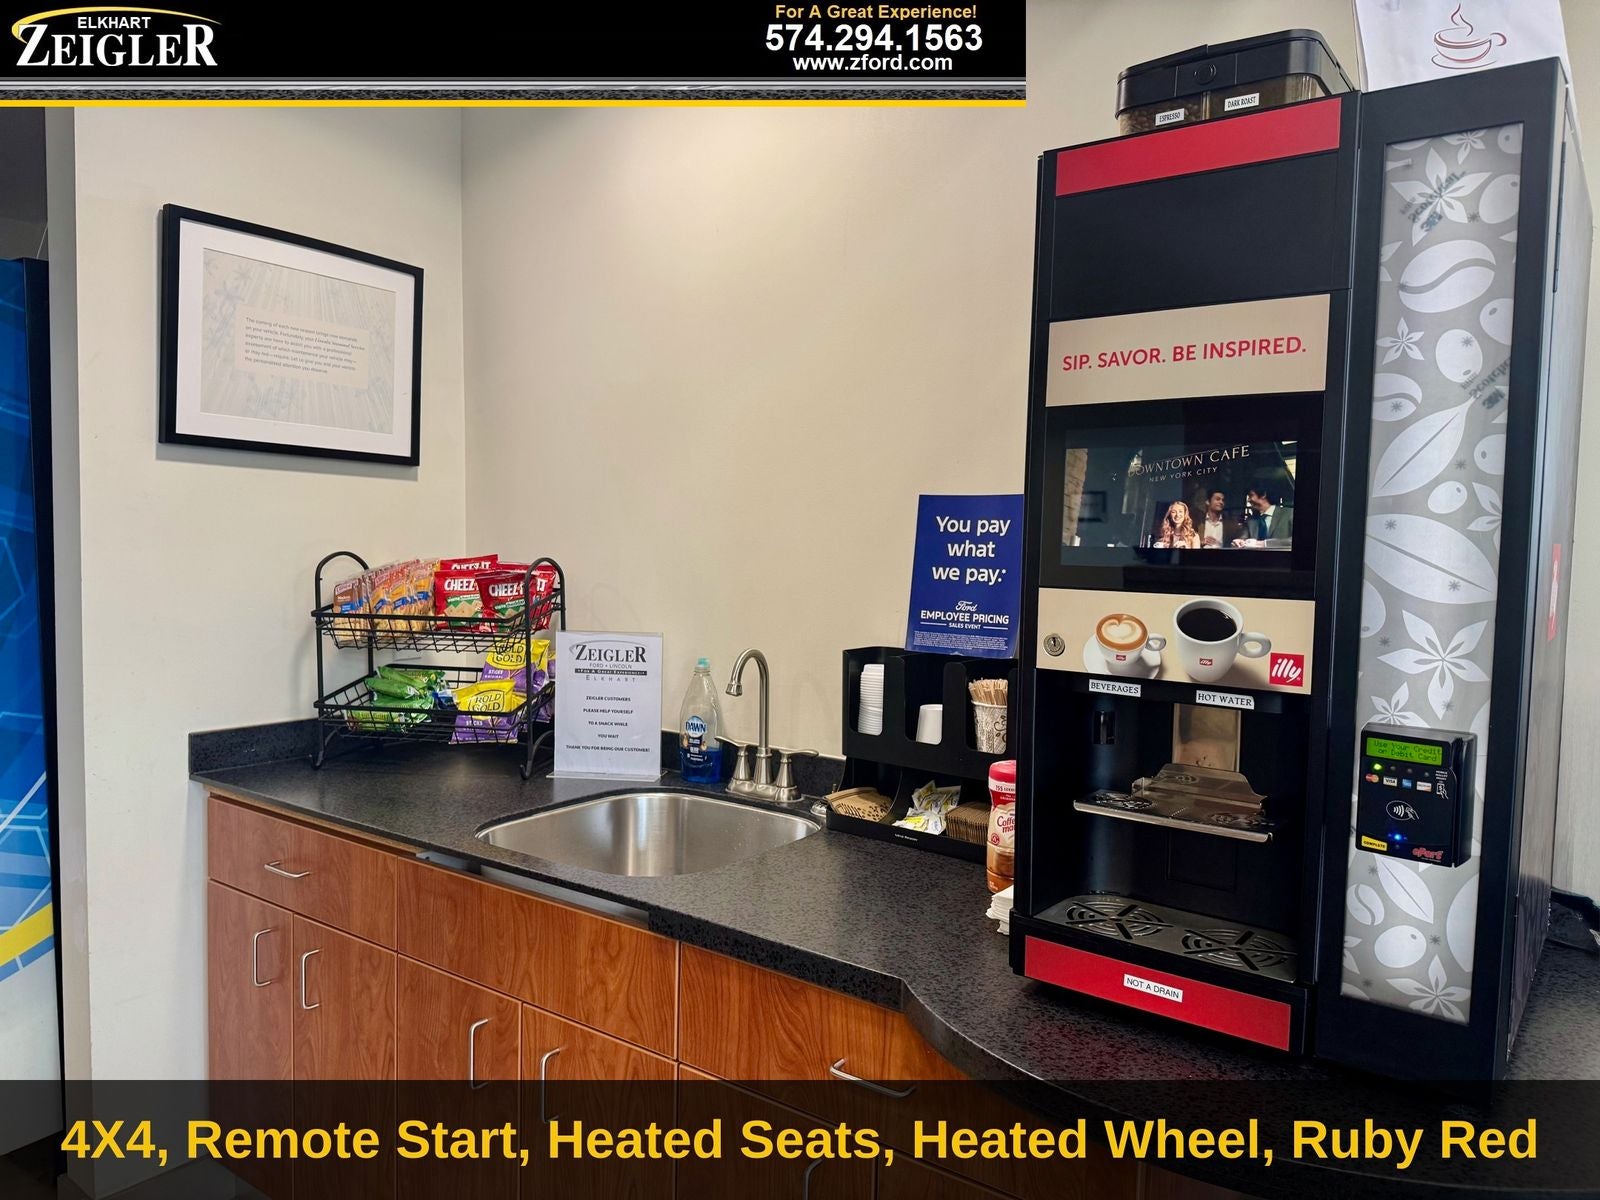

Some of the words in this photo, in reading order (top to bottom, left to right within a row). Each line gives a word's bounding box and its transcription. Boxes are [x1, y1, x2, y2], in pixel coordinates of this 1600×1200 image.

[1228, 99, 1240, 109] DARK
[1241, 96, 1256, 106] ROAST
[1159, 111, 1181, 123] ESPRESSO
[1062, 353, 1092, 371] SIP.
[1097, 348, 1166, 369] SAVOR.
[1172, 344, 1197, 362] BE
[1202, 336, 1306, 360] INSPIRED.
[1128, 454, 1204, 477] DOWNTOWN
[1210, 445, 1250, 463] CAFE
[1149, 474, 1167, 483] NEW
[1170, 471, 1192, 480] YORK
[1196, 466, 1218, 476] CITY
[936, 516, 971, 534] You
[976, 519, 1011, 537] pay
[947, 540, 996, 558] what
[932, 567, 960, 581] we
[955, 600, 978, 612] Ford
[920, 610, 970, 623] EMPLOYEE
[972, 613, 1010, 625] PRICING
[949, 622, 963, 630] SALES
[575, 644, 647, 664] ZEIGLER
[585, 674, 636, 682] ELKHART
[1271, 658, 1302, 684] illy
[1090, 682, 1139, 695] BEVERAGES
[1197, 692, 1215, 704] HOT
[1217, 695, 1253, 707] WATER
[685, 721, 706, 733] DAWN
[1374, 739, 1388, 748] Use
[1391, 740, 1408, 751] Your
[1413, 744, 1442, 755] Credit
[1391, 749, 1413, 758] Debit
[1417, 753, 1437, 761] Card
[996, 815, 1015, 827] Coffe
[1363, 840, 1386, 849] COMPLETE
[1127, 977, 1144, 989] NOT
[1145, 983, 1152, 991] A
[1153, 985, 1179, 999] DRAIN
